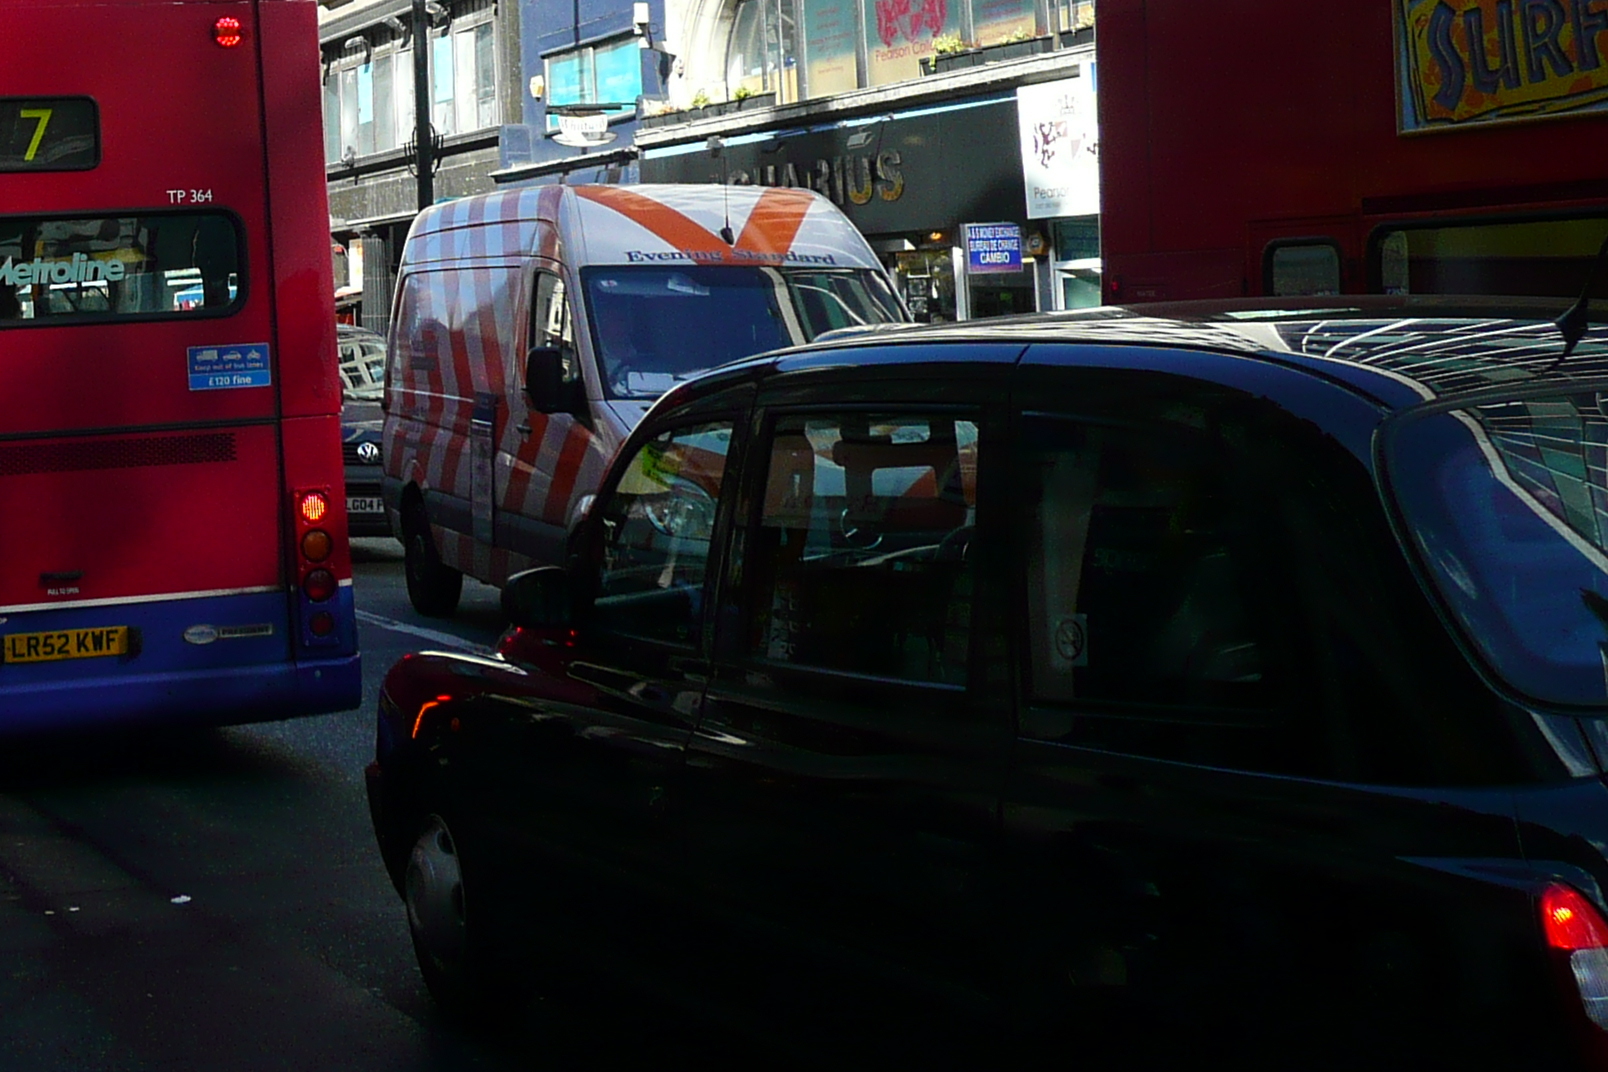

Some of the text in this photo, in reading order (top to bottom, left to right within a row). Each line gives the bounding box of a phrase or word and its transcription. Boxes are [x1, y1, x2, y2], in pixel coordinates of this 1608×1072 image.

[876, 47, 910, 62] Pearson
[20, 109, 52, 161] 7
[728, 151, 904, 205] ARIUS
[166, 189, 213, 204] TP 364
[970, 239, 1019, 251] BUREAU DE CHANGE
[625, 248, 838, 266] Evening Standard
[980, 251, 1010, 264] CAMBIO
[208, 374, 252, 386] £120 fine
[47, 588, 59, 597] PULL
[11, 629, 120, 659] LR52 KWF
